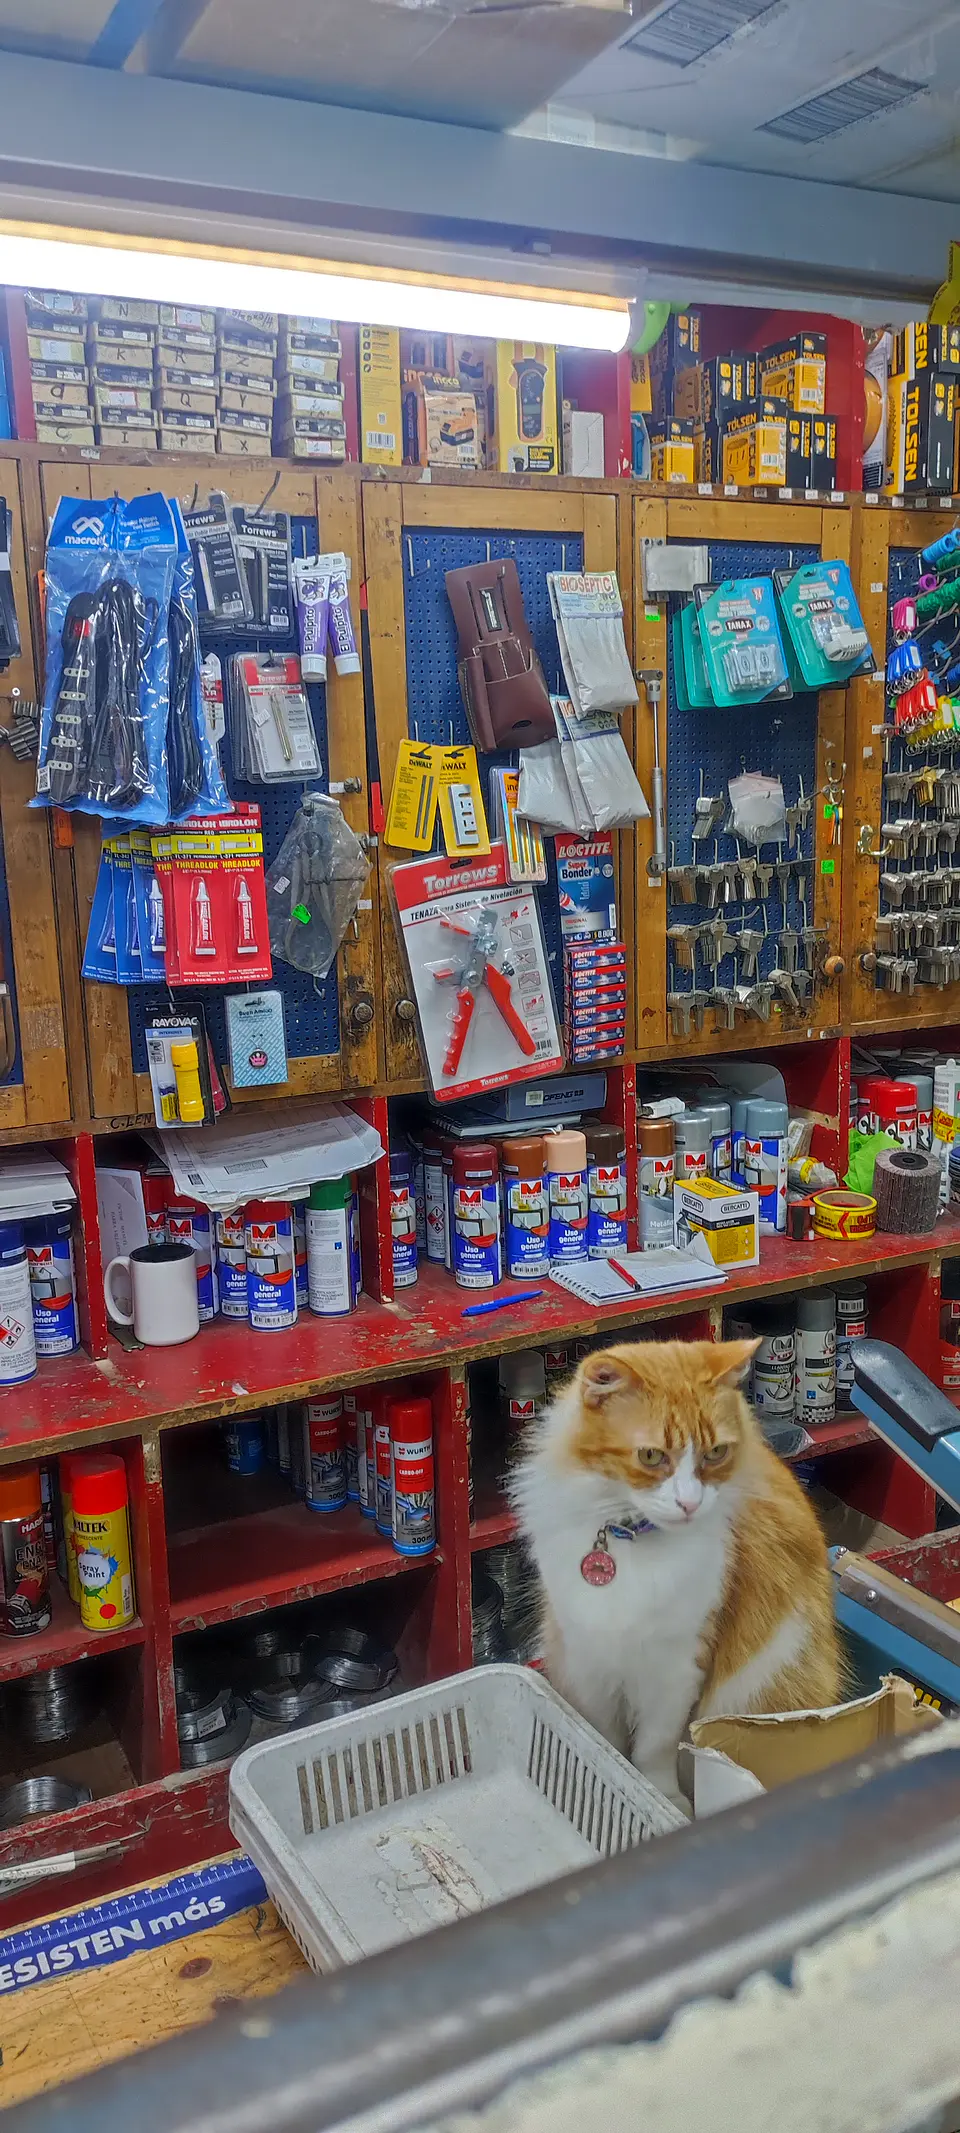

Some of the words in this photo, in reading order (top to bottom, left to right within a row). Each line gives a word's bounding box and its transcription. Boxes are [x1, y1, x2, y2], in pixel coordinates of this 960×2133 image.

[119, 304, 129, 316] N
[915, 322, 929, 369] SEN
[176, 348, 186, 364] R
[765, 350, 797, 369] TOLSEN
[802, 352, 825, 361] TOLSEN
[180, 393, 191, 408] Q
[239, 394, 248, 408] Y
[727, 413, 757, 432] TOLSEN
[762, 415, 787, 424] TOLSEN
[905, 386, 920, 481] TOLSEN
[670, 435, 693, 443] TOLSEN
[240, 440, 249, 452] X
[241, 524, 277, 537] Torrews
[560, 576, 612, 592] BIOSEPTIC
[810, 601, 833, 611] TANAX
[305, 608, 316, 641] Pulpito
[334, 607, 349, 641] Pulpito
[727, 621, 752, 630] TANAX
[440, 762, 467, 771] eWALT
[559, 842, 610, 858] LOCTITE
[176, 862, 219, 870] THREADLOK
[567, 861, 587, 870] Super
[562, 868, 592, 879] Bonder
[423, 865, 499, 893] Torrews
[490, 887, 523, 901] Nivelación
[574, 950, 597, 959] LOCTITE
[574, 969, 597, 979] LOCTITE
[574, 988, 597, 998] LOCTITE
[574, 1008, 597, 1017] LOCTITE
[152, 1017, 199, 1028] RAYOVAC
[574, 1027, 596, 1036] LOCTITE
[574, 1045, 596, 1053] LOCTITE
[480, 1074, 509, 1086] Torrews
[543, 1091, 573, 1101] OFENG
[684, 1196, 701, 1211] BERCATTI
[724, 1203, 748, 1212] BERCATTI
[603, 1221, 617, 1229] Uso
[598, 1226, 622, 1235] general
[526, 1236, 541, 1244] Uso
[559, 1234, 584, 1243] general
[393, 1245, 407, 1253] Uso
[520, 1241, 545, 1251] general
[392, 1249, 412, 1258] eneral
[460, 1251, 485, 1260] general
[226, 1279, 247, 1288] gener
[254, 1290, 281, 1299] general
[35, 1309, 52, 1317] Uso
[315, 1427, 337, 1436] CARBO-OFF
[407, 1445, 431, 1455] WURTH
[79, 1562, 100, 1573] Spray
[84, 1570, 106, 1579] Paint
[0, 1919, 146, 1990] ESISTEN
[149, 1895, 226, 1936] más
